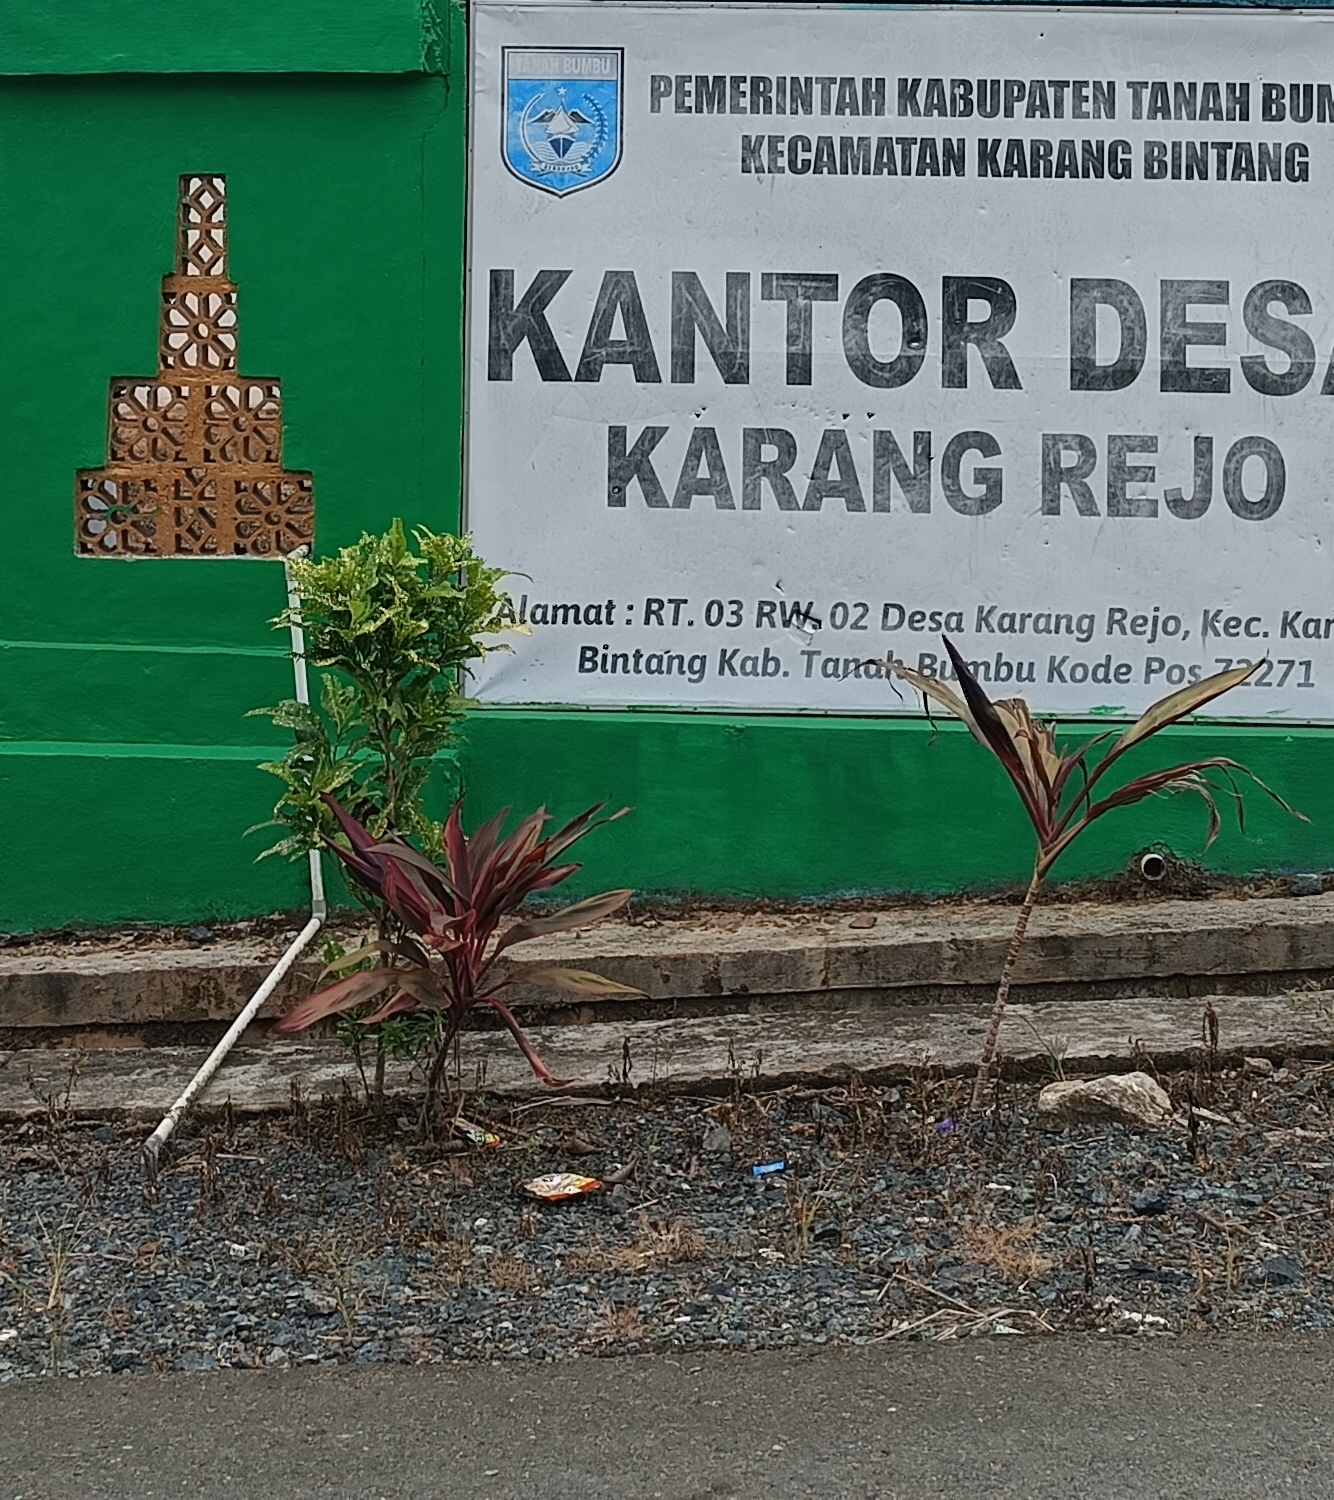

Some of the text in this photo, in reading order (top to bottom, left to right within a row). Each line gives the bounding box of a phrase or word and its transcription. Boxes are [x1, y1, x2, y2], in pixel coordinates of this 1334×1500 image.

[563, 57, 610, 74] BUMBU
[650, 75, 886, 117] PEMERINTAH
[897, 78, 1116, 119] KABUPATEN
[1127, 80, 1250, 121] TANAH
[741, 135, 1309, 182] KECAMATAN KARANG BINTANG
[487, 269, 1023, 389] KANTOR
[607, 425, 1286, 521] KARANG REJO
[495, 594, 615, 625] Alamat
[643, 598, 694, 626] RT.
[704, 600, 743, 628] 03
[755, 601, 820, 631] RW.
[829, 602, 869, 631] 02
[881, 603, 964, 633] Desa
[975, 605, 1095, 642] Karang
[1107, 607, 1190, 643] Rejo,
[1201, 609, 1269, 638] Kec.
[578, 644, 706, 683] Bintang
[718, 648, 789, 678] Kab.
[800, 650, 905, 680] Tanah
[917, 652, 1036, 683] Bumbu
[1047, 655, 1132, 684] Kode
[1144, 657, 1202, 685] Pos
